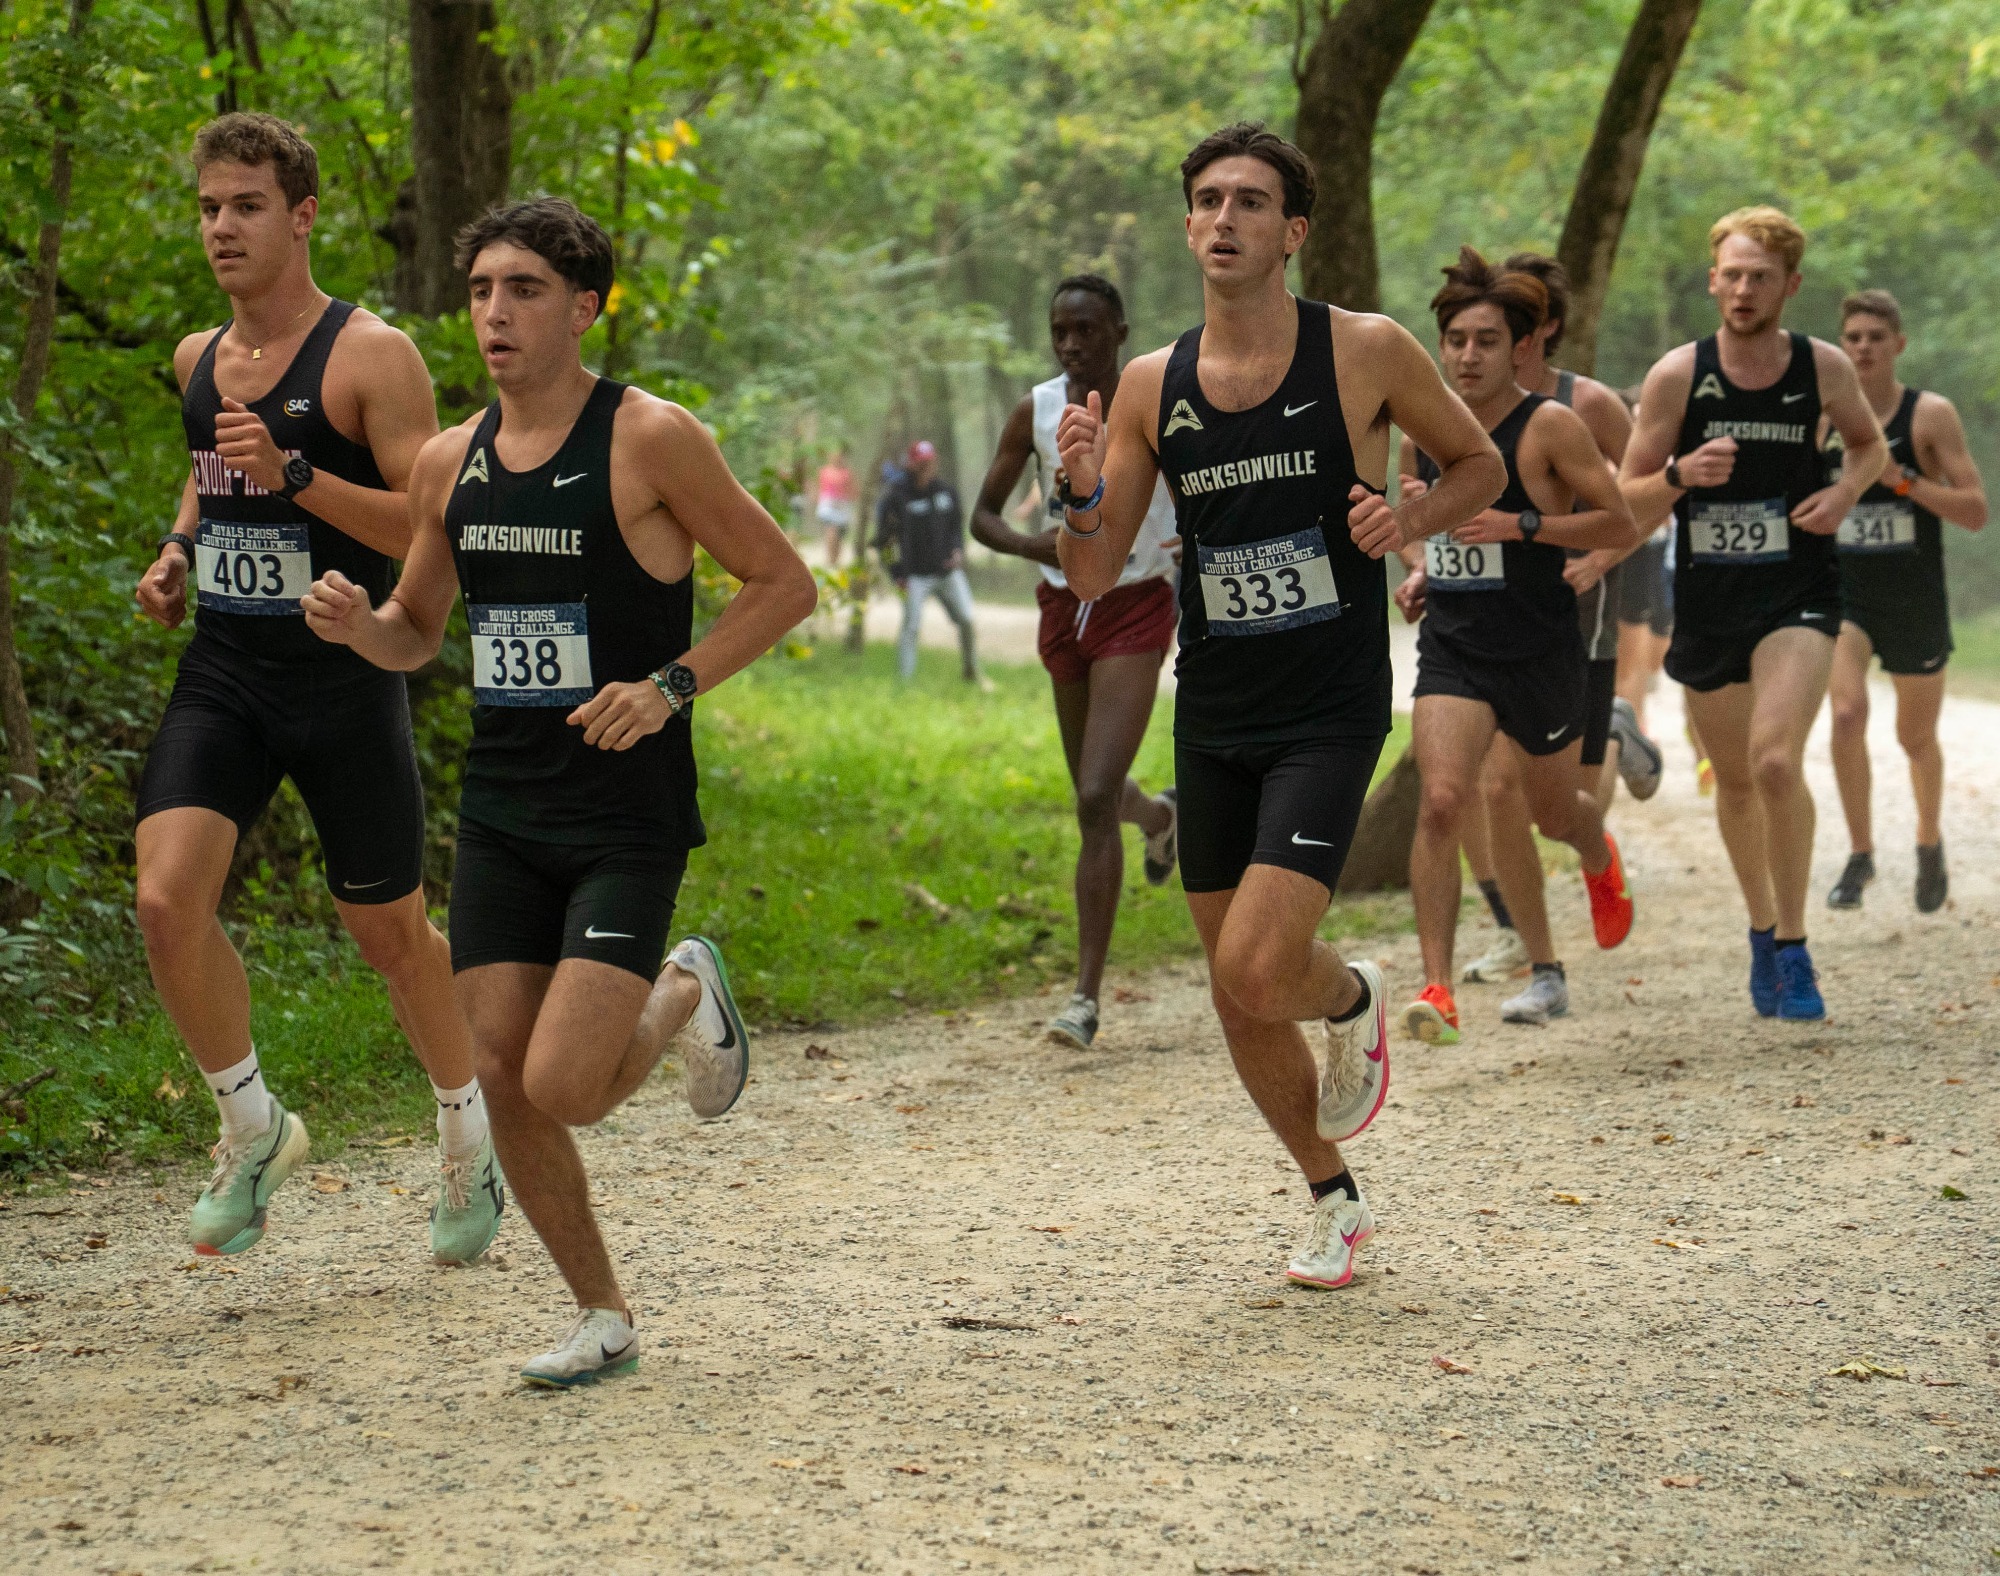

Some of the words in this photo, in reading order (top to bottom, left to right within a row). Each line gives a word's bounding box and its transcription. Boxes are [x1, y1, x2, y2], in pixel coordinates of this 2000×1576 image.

[287, 399, 310, 411] SAC
[1703, 420, 1806, 443] JACKSONVILLE
[1180, 450, 1317, 497] JACKSONVILLE
[201, 533, 236, 549] COUNTRY
[239, 539, 298, 551] CHALLENGE
[211, 523, 244, 538] ROYALS
[246, 527, 280, 540] CROSS
[459, 525, 583, 556] JACKSONVILLE
[1710, 522, 1768, 551] 329
[1853, 519, 1894, 541] 341
[1204, 561, 1247, 575] COUNTRY
[1250, 546, 1315, 572] CHALLENGE
[1213, 548, 1254, 563] ROYALS
[1256, 540, 1295, 558] CROSS
[1434, 545, 1485, 577] 330
[213, 551, 284, 597] 403
[1220, 567, 1307, 619] 333
[478, 622, 511, 635] COUNTRY
[514, 621, 576, 635] CHALLENGE
[488, 609, 518, 622] ROYALS
[520, 609, 556, 622] CROSS
[490, 638, 562, 687] 338
